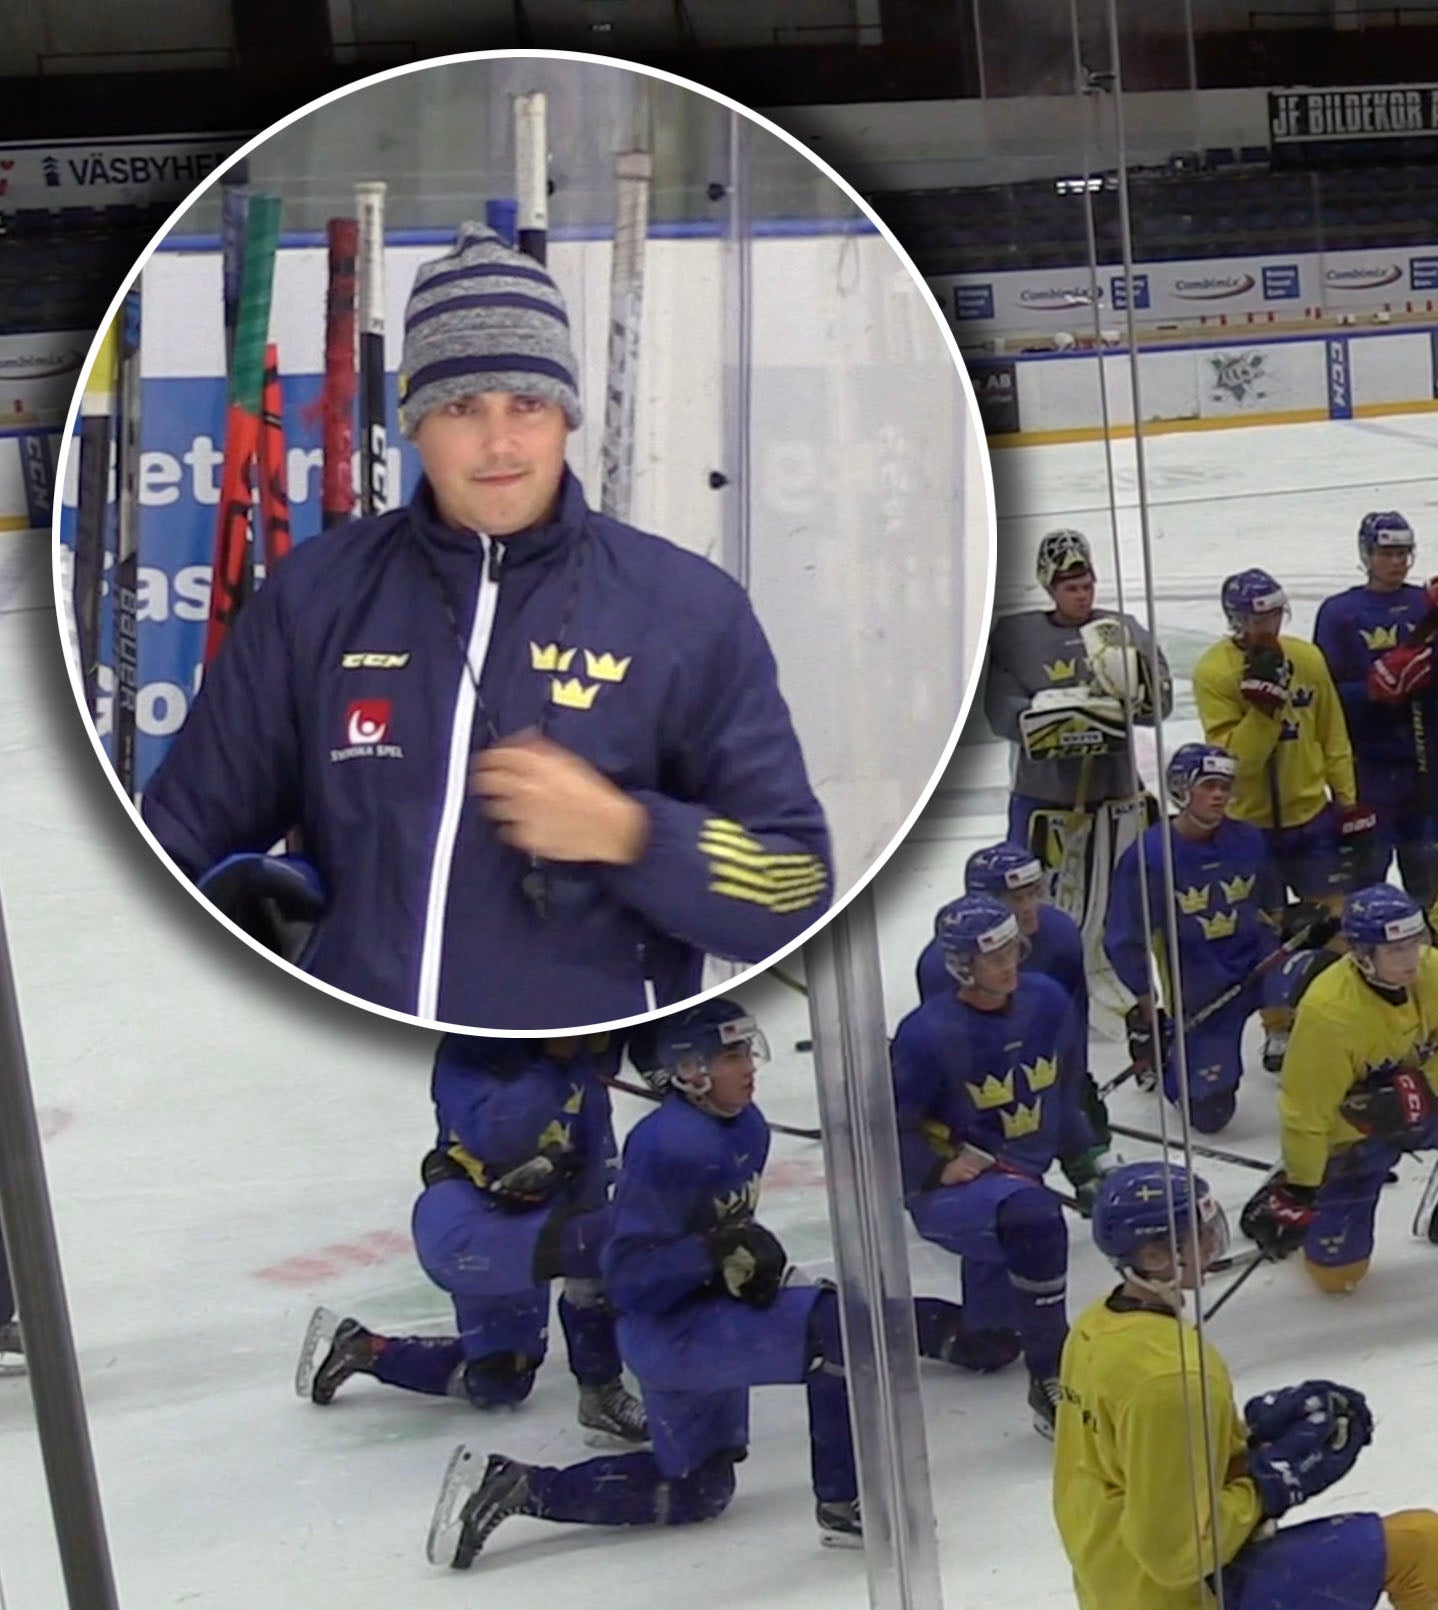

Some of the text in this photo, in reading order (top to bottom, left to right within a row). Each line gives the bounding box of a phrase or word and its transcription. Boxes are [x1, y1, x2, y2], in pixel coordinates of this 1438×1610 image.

[1308, 90, 1423, 134] BILDEKOR
[1330, 340, 1346, 407] CCM
[342, 652, 410, 668] CCM
